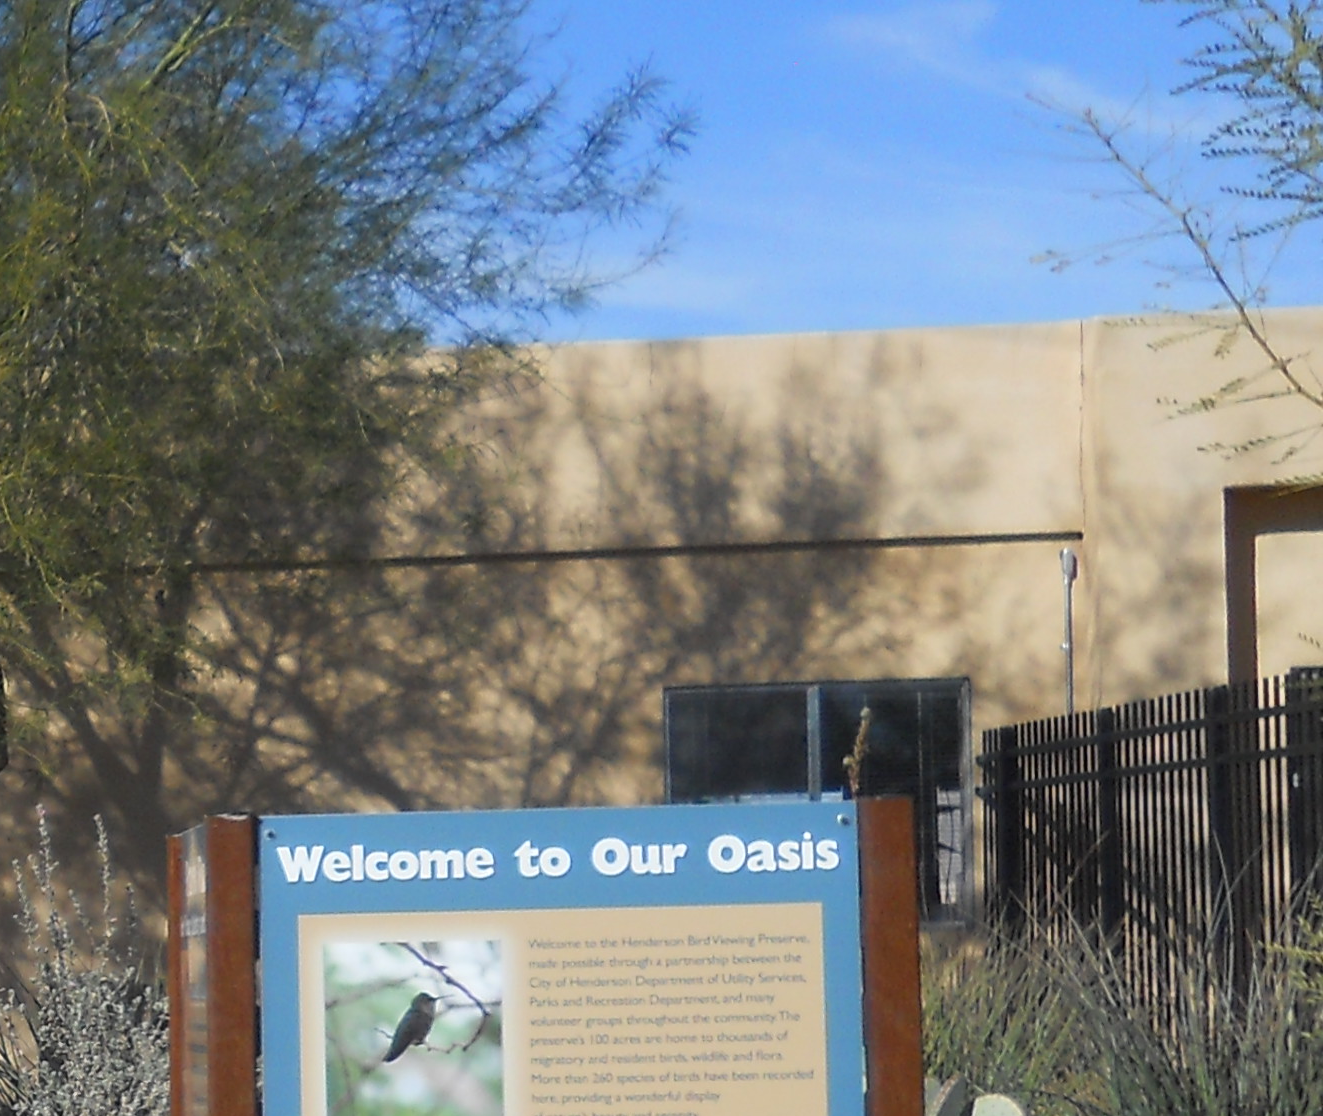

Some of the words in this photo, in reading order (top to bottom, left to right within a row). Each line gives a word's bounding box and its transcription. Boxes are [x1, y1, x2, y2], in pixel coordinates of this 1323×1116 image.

[276, 844, 494, 884] Welcome
[513, 840, 571, 877] to
[591, 837, 687, 875] Our
[708, 832, 841, 873] Oasis
[528, 939, 581, 949] Welcome
[600, 938, 618, 948] the
[622, 937, 685, 948] Henderson
[687, 935, 710, 946] Bird
[712, 935, 755, 947] Viewing
[528, 958, 558, 969] made
[561, 957, 606, 970] possible
[609, 956, 653, 970] through
[656, 958, 662, 966] a
[665, 954, 729, 968] partnership
[732, 954, 781, 965] between
[783, 952, 802, 963] the
[529, 977, 552, 991] City
[555, 977, 567, 988] of
[569, 976, 632, 987] Henderson
[635, 975, 703, 988] Department
[707, 974, 719, 984] of
[722, 973, 755, 986] Utility
[529, 996, 559, 1008] Parks
[562, 996, 583, 1007] and
[585, 995, 646, 1006] Recreation
[722, 992, 743, 1004] and
[746, 995, 775, 1005] many
[530, 1016, 582, 1027] volunteer
[585, 1017, 623, 1029] groups
[626, 1015, 689, 1027] throughout
[692, 1014, 710, 1024] the
[779, 1010, 800, 1021] The
[590, 1034, 610, 1045] 100
[611, 1036, 641, 1045] acres
[644, 1036, 662, 1044] are
[665, 1034, 698, 1044] home
[701, 1034, 714, 1043] to
[717, 1031, 773, 1042] thousands
[776, 1030, 789, 1041] of
[531, 1057, 585, 1068] migratory
[588, 1054, 609, 1064] and
[610, 1053, 656, 1064] resident
[691, 1051, 729, 1062] wildlife
[732, 1050, 753, 1062] and
[531, 1074, 561, 1084] More
[564, 1074, 589, 1084] than
[616, 1074, 655, 1086] species
[659, 1072, 670, 1082] of
[673, 1072, 701, 1082] birds
[704, 1072, 729, 1081] have
[732, 1071, 759, 1081] been
[763, 1069, 814, 1080] recorded
[561, 1092, 612, 1106] providing
[624, 1091, 681, 1102] wonderful
[685, 1090, 721, 1103] display
